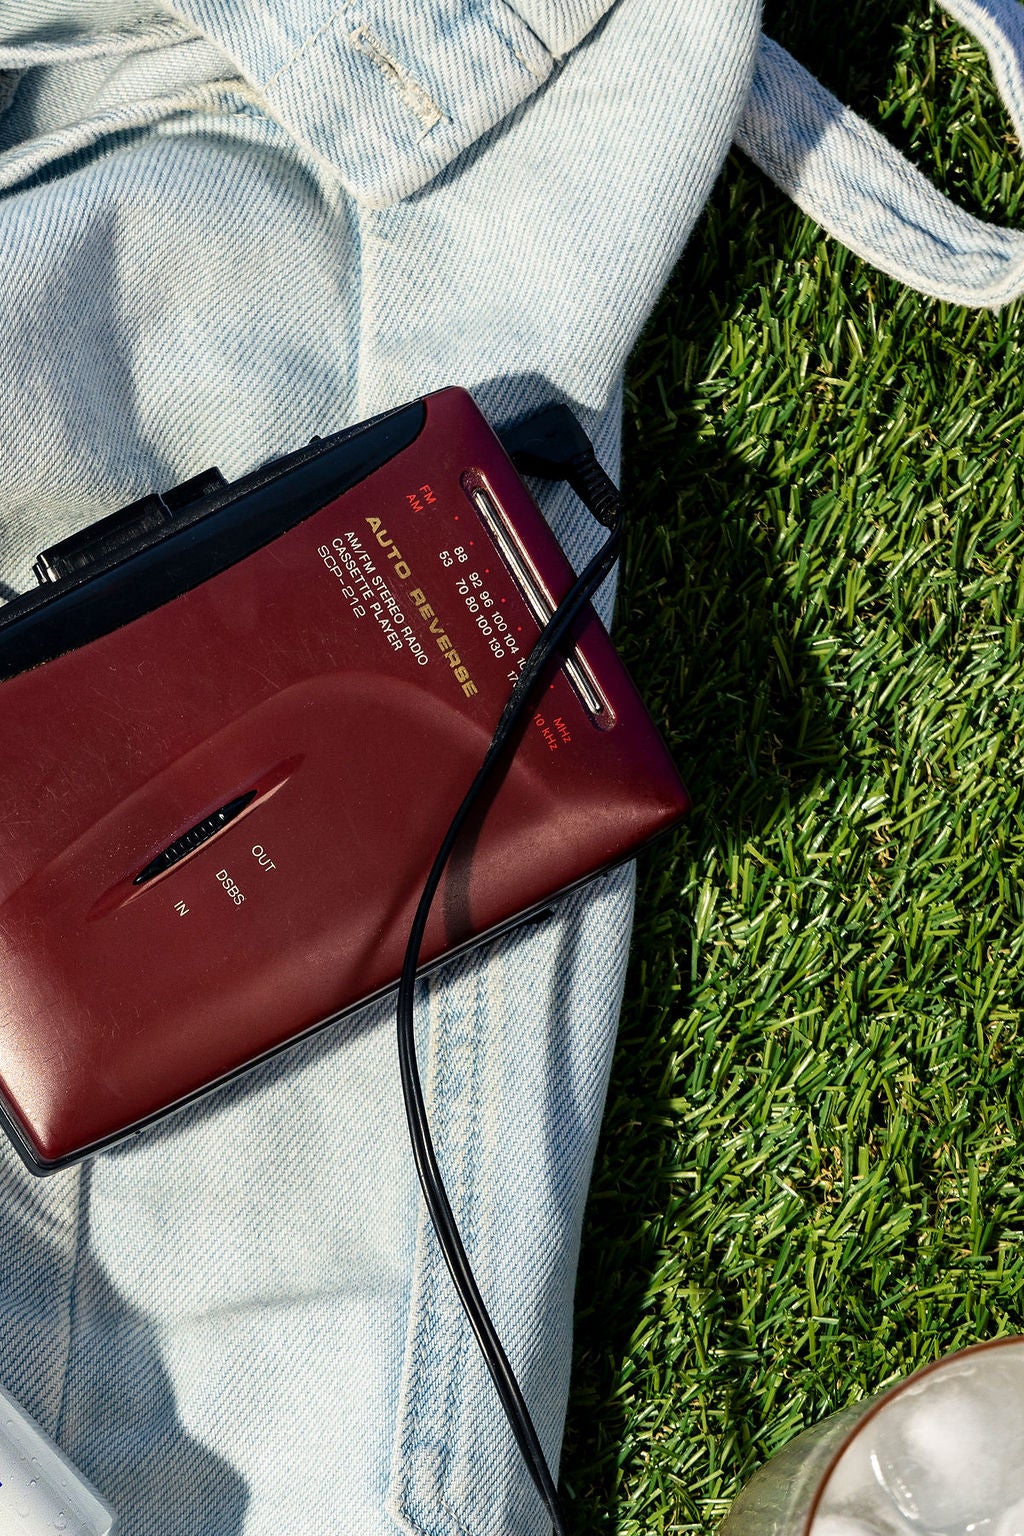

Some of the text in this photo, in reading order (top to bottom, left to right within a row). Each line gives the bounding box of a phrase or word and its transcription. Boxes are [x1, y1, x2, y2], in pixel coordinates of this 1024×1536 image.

[317, 545, 366, 618] SCP-212
[332, 538, 403, 651] CASSETTE PLAYER
[344, 531, 428, 666] AM/FM STEREO RADIO
[365, 517, 479, 698] AUTO REVERSE
[406, 493, 423, 513] AM
[439, 550, 454, 568] 53
[455, 578, 469, 595] 70
[465, 596, 479, 613] 80
[475, 615, 492, 636] 100
[488, 637, 505, 659] 130
[533, 713, 545, 727] 10
[542, 727, 558, 751] kHz
[419, 484, 437, 504] FM
[454, 546, 468, 563] 88
[469, 572, 483, 588] 92
[479, 590, 494, 608] 96
[491, 611, 507, 632] 100
[503, 633, 519, 654] 104
[553, 717, 571, 743] MHz
[174, 901, 189, 917] IN
[216, 869, 245, 906] DSBS
[252, 845, 276, 872] OUT
